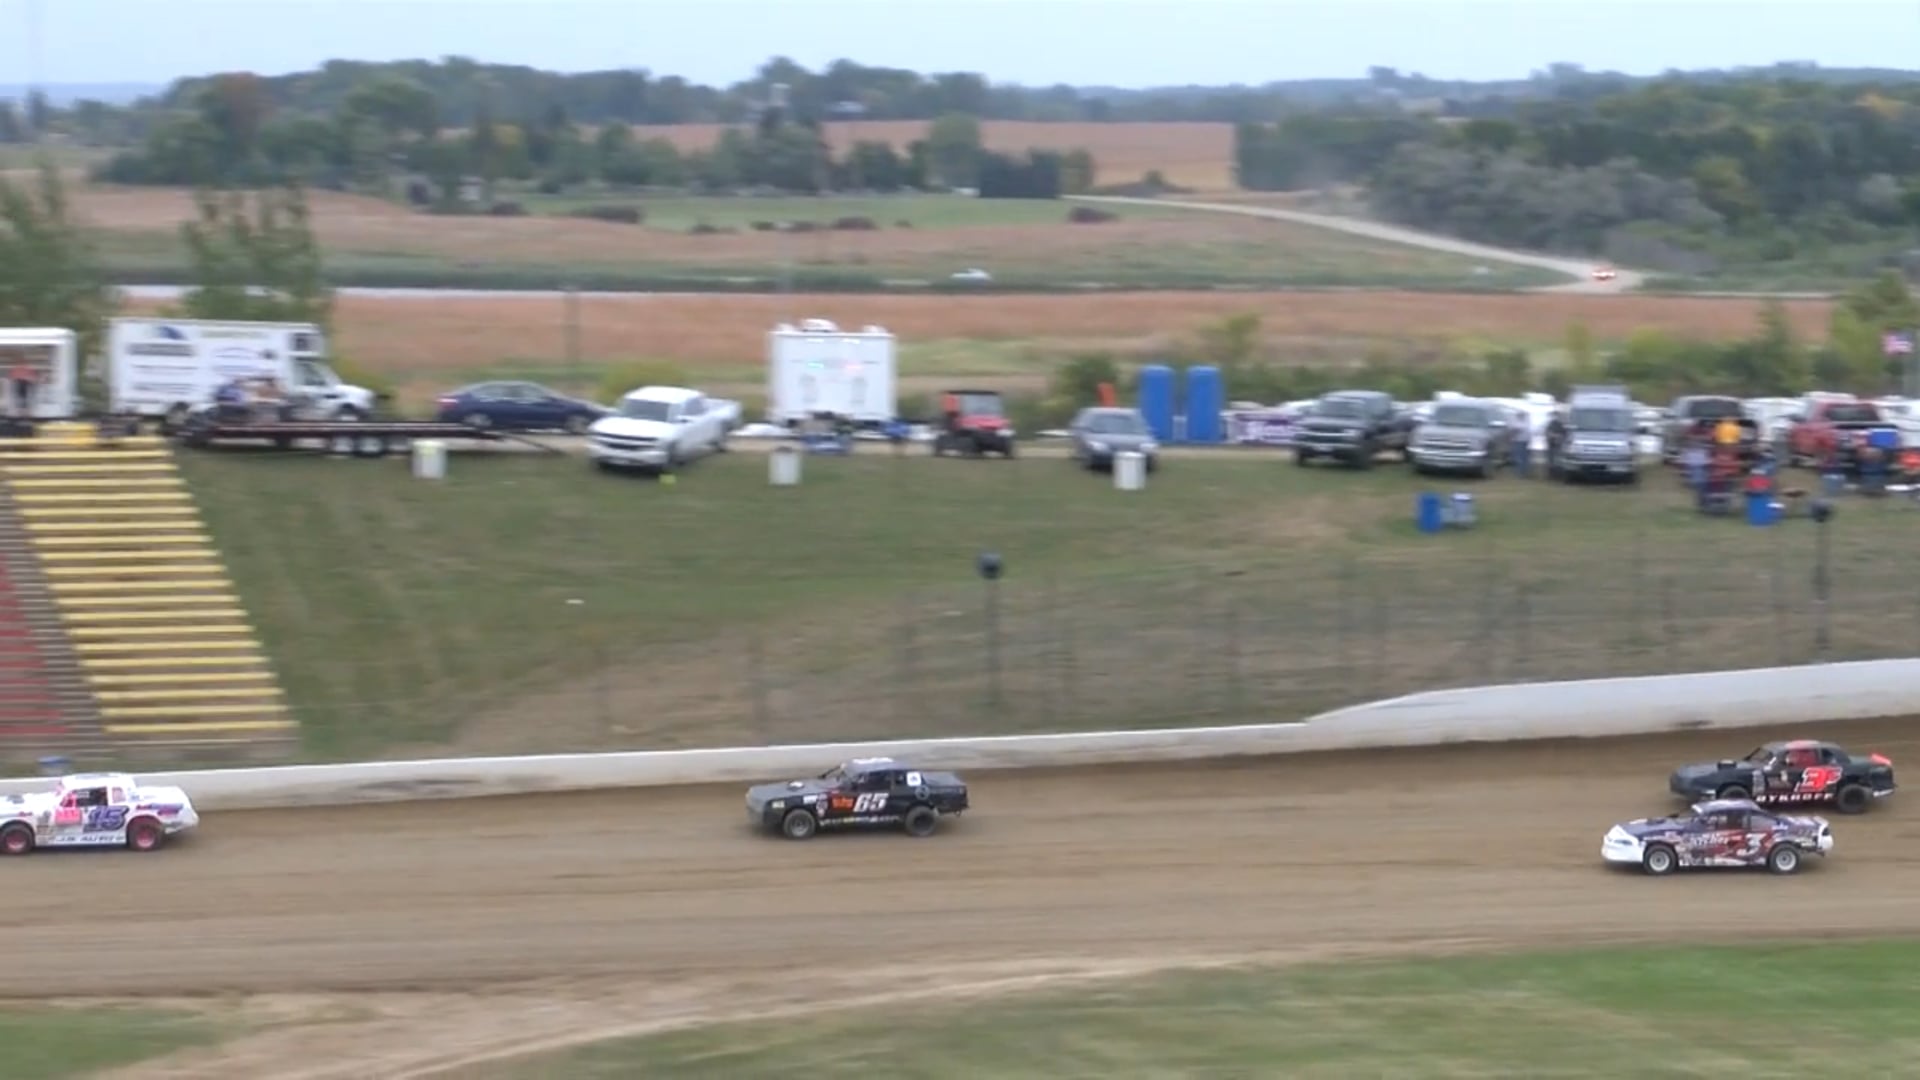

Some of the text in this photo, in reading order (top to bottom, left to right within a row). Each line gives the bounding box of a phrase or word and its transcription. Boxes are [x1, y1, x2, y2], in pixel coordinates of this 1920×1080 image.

[853, 792, 889, 812] 65
[82, 805, 130, 834] 15
[1736, 832, 1768, 857] 3
